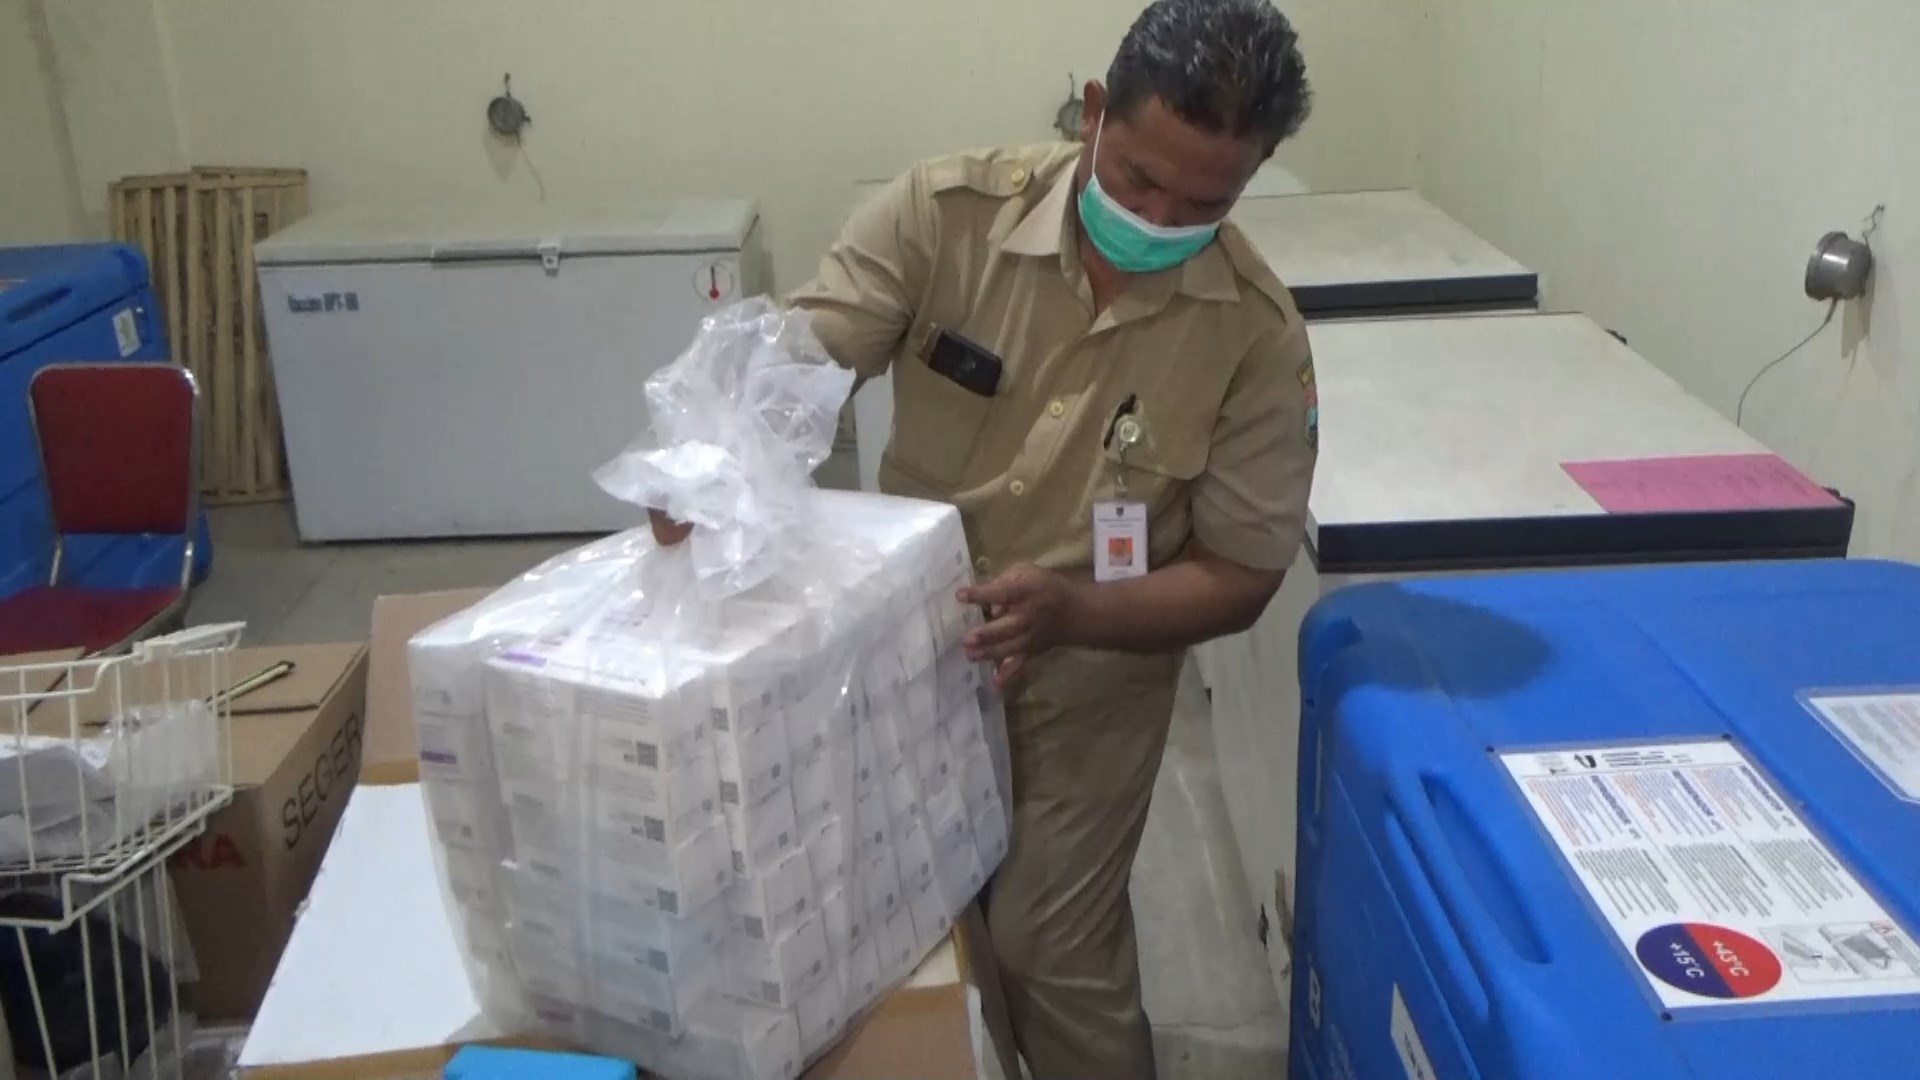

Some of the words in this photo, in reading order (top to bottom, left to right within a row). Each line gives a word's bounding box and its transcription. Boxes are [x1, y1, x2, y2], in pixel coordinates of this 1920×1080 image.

[281, 711, 363, 851] SEGER
[1669, 942, 1706, 978] +15°C
[1712, 940, 1750, 978] +43°C
